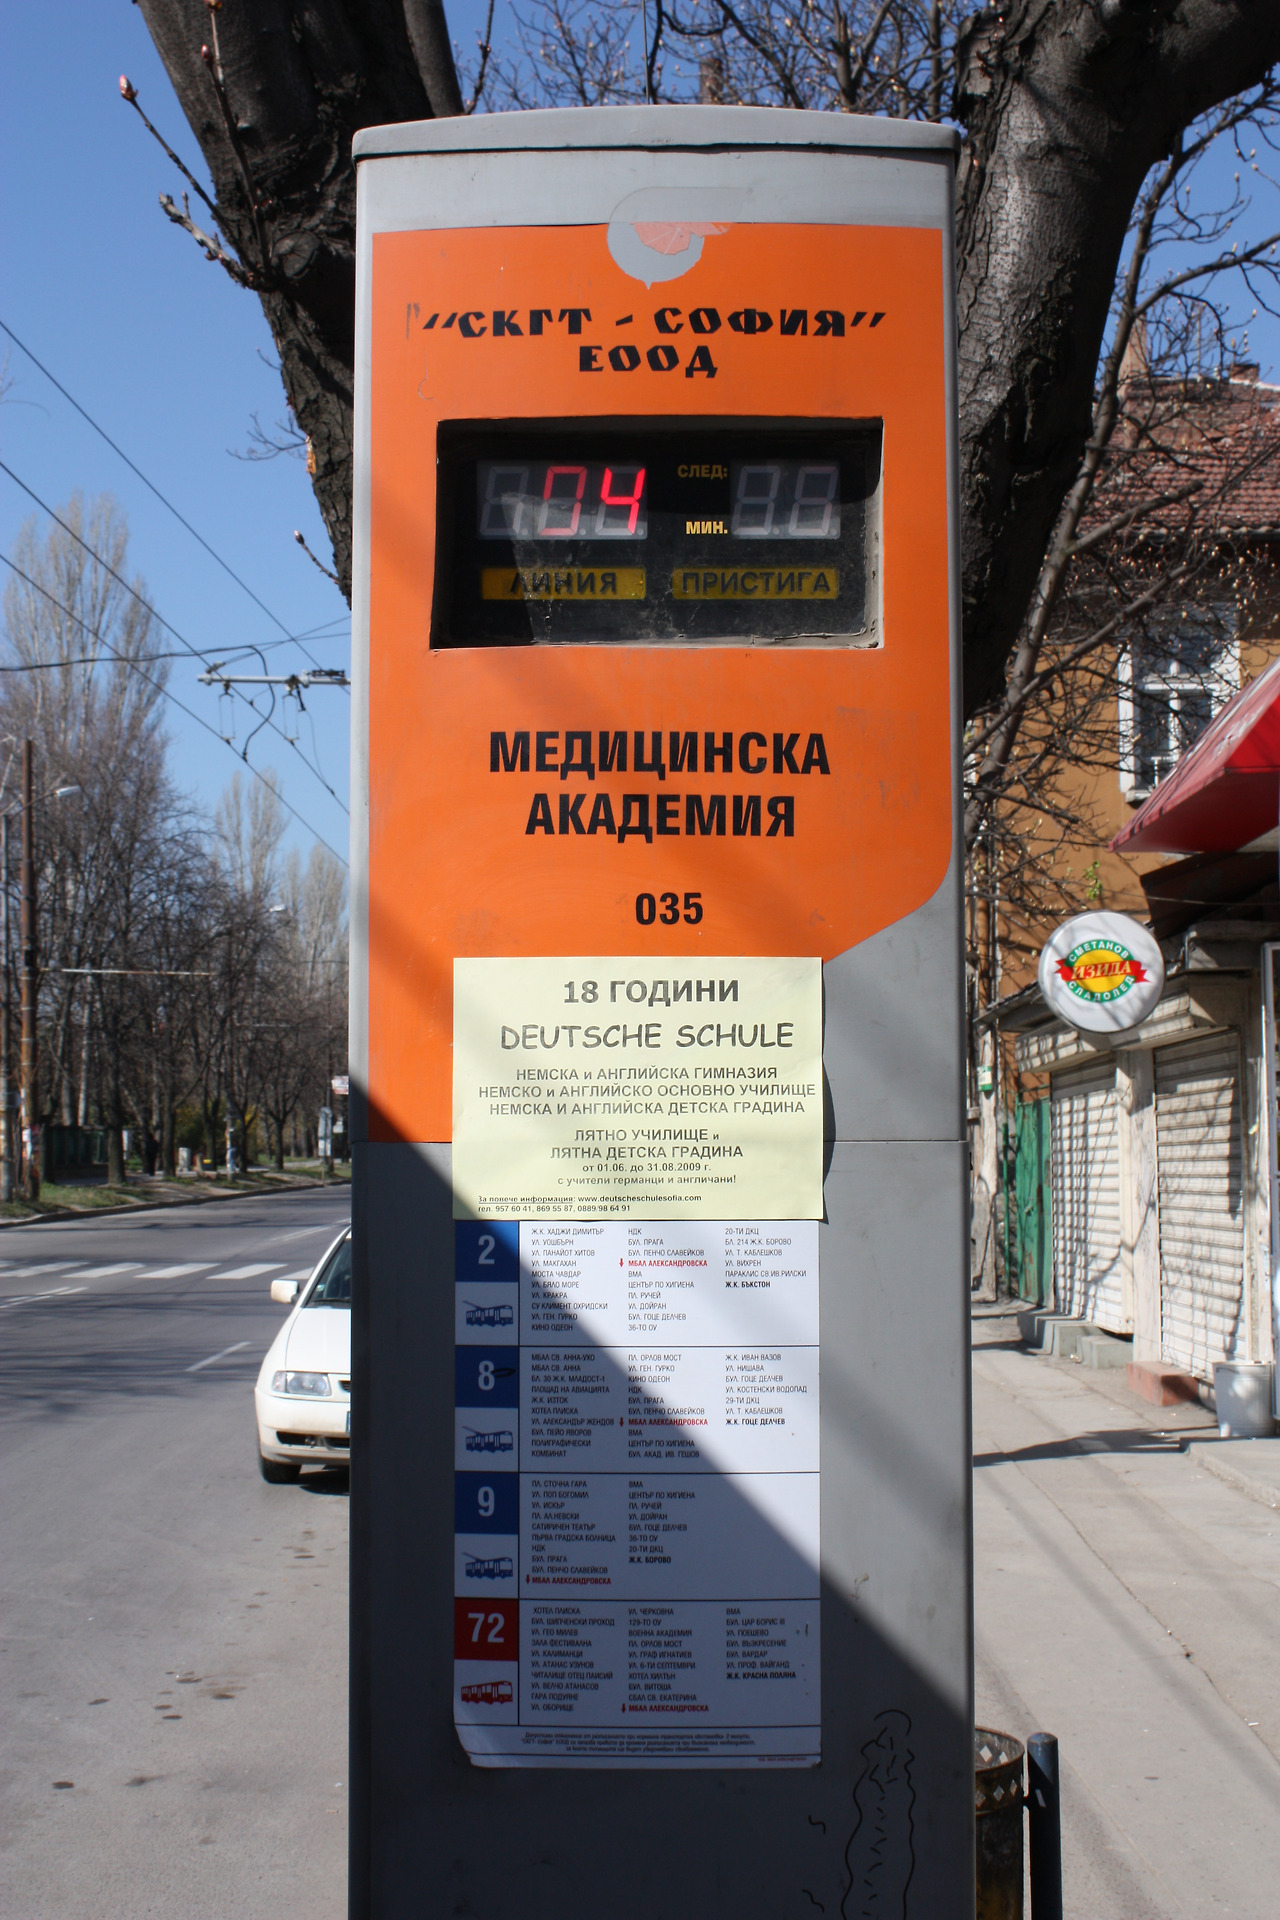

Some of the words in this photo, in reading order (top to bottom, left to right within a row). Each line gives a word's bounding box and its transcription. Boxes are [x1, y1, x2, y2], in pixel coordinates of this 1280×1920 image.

[579, 345, 718, 378] ЕООД
[678, 464, 728, 479] СЛЕД:
[686, 521, 728, 535] МИН.
[510, 572, 617, 595] ЛИНИЯ
[682, 572, 831, 594] ПРИСТИГА
[490, 731, 830, 780] МЕДИЦИНСКА
[526, 793, 794, 843] АКАДЕМИЯ
[635, 892, 703, 925] 035
[1069, 941, 1129, 962] СМЕТАНОВ
[1072, 961, 1131, 979] ИЗИДА
[564, 981, 598, 1003] 18
[610, 980, 738, 1007] ГОДИНИ
[1069, 976, 1135, 1001] СЛАДОЛЕД
[501, 1024, 661, 1049] DEUTSCHE
[676, 1022, 793, 1047] SCHULE
[517, 1069, 578, 1080] НЕМСКА
[597, 1065, 689, 1079] АНГЛИЙСКА
[694, 1068, 777, 1079] ГИМНАЗИЯ
[479, 1087, 541, 1098] НЕМСКО
[560, 1083, 652, 1097] АНГЛИЙСКО
[658, 1085, 734, 1096] ОСНОВНО
[740, 1084, 815, 1097] УЧИЛИЩЕ
[490, 1104, 552, 1115] НЕМСКА
[558, 1104, 566, 1114] И
[572, 1100, 663, 1114] АНГЛИЙСКА
[668, 1102, 728, 1115] ДЕТСКА
[734, 1102, 805, 1115] ГРАДИНА
[575, 1130, 626, 1141] ЛЯТНО
[632, 1129, 708, 1142] УЧИЛИЩЕ
[551, 1147, 601, 1158] ЛЯТНА
[606, 1147, 666, 1160] ДЕТСКА
[672, 1146, 743, 1159] ГРАДИНА
[597, 1164, 626, 1172] 01.06.
[647, 1163, 701, 1171] 31.08.2009
[567, 1177, 610, 1186] учители
[614, 1177, 664, 1186] германци
[678, 1175, 736, 1184] англичани!
[478, 1235, 495, 1264] 2
[628, 1260, 647, 1268] МБАЛ
[648, 1260, 707, 1268] АЛЕКСАНДРОВСКА
[628, 1281, 653, 1289] ЦЕНТЪР
[654, 1281, 664, 1289] ПО
[665, 1281, 694, 1289] ХИГИЕНА
[478, 1360, 495, 1391] 8
[628, 1418, 647, 1426] МБАЛ
[649, 1418, 708, 1426] АЛЕКСАНДРОВСКА
[725, 1418, 740, 1426] Ж.К.
[741, 1418, 758, 1426] ГОЦЕ
[760, 1418, 785, 1426] ДЕЛЧЕВ
[477, 1486, 495, 1517] 9
[468, 1612, 504, 1643] 72
